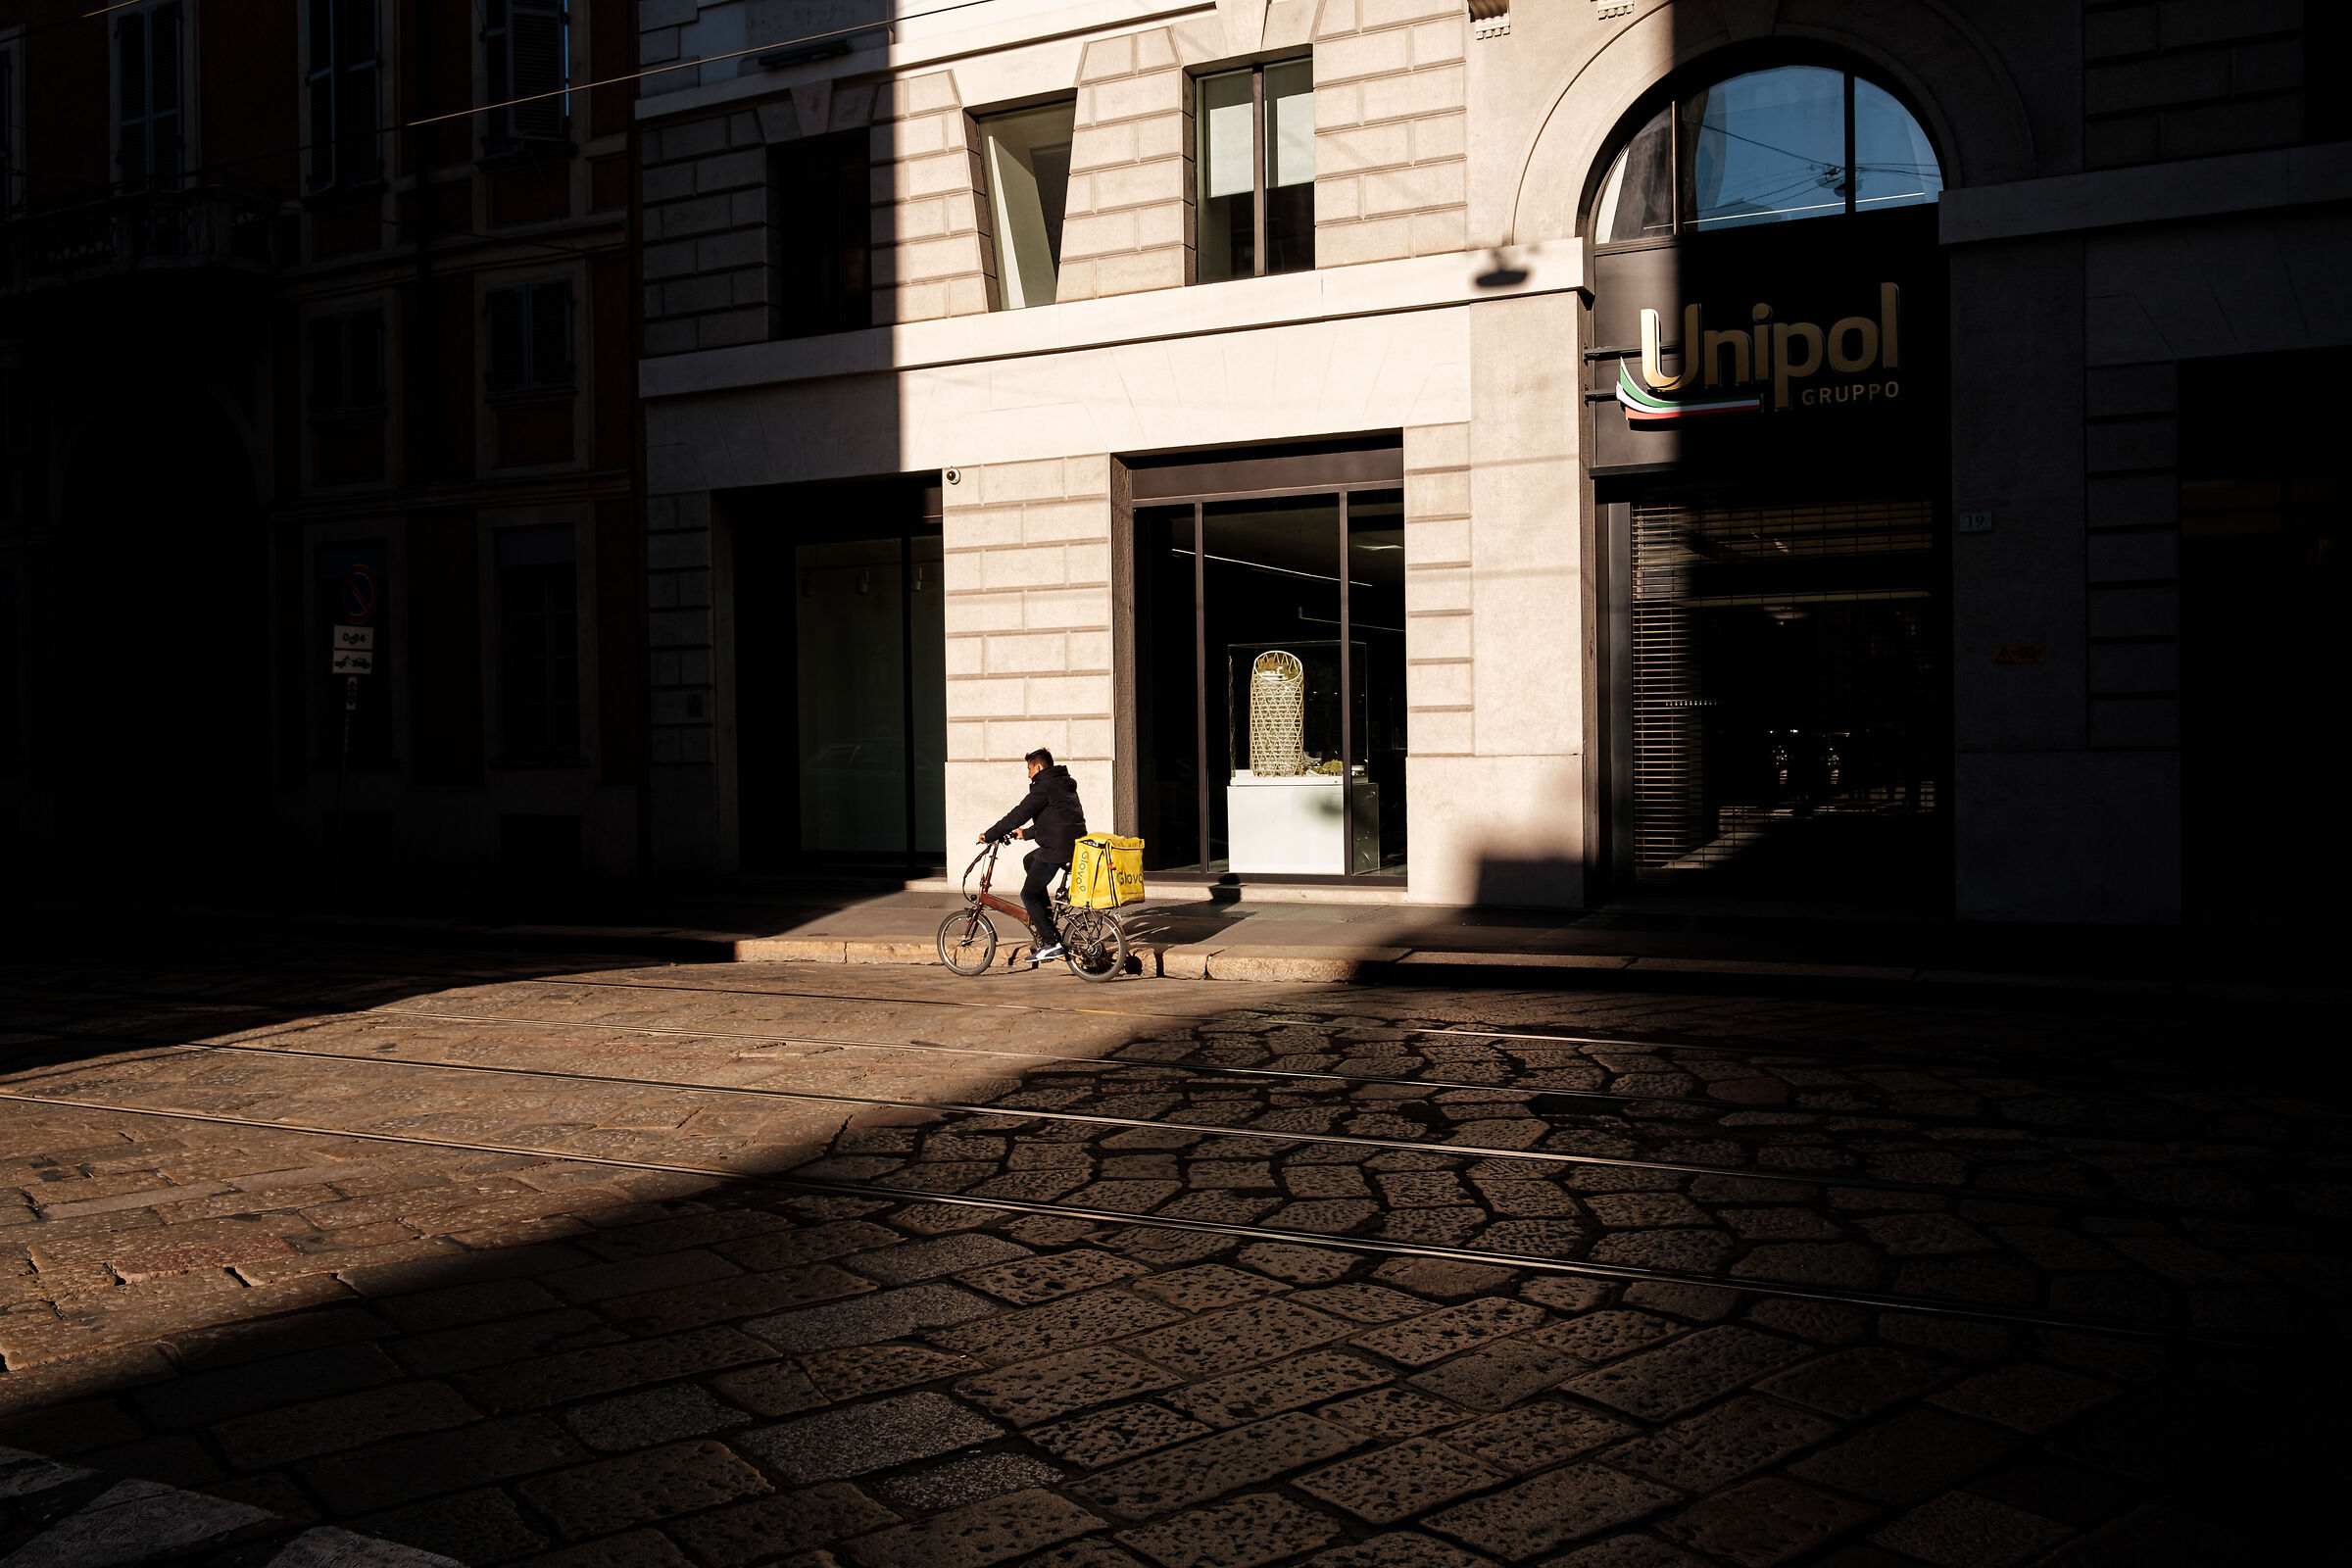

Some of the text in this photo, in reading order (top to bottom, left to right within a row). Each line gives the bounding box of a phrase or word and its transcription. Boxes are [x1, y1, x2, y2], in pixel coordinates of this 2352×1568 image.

[1640, 281, 1900, 412] Unipol
[1800, 380, 1900, 407] GRUPPO
[1968, 515, 1984, 527] 19
[1076, 851, 1089, 885] Glovo
